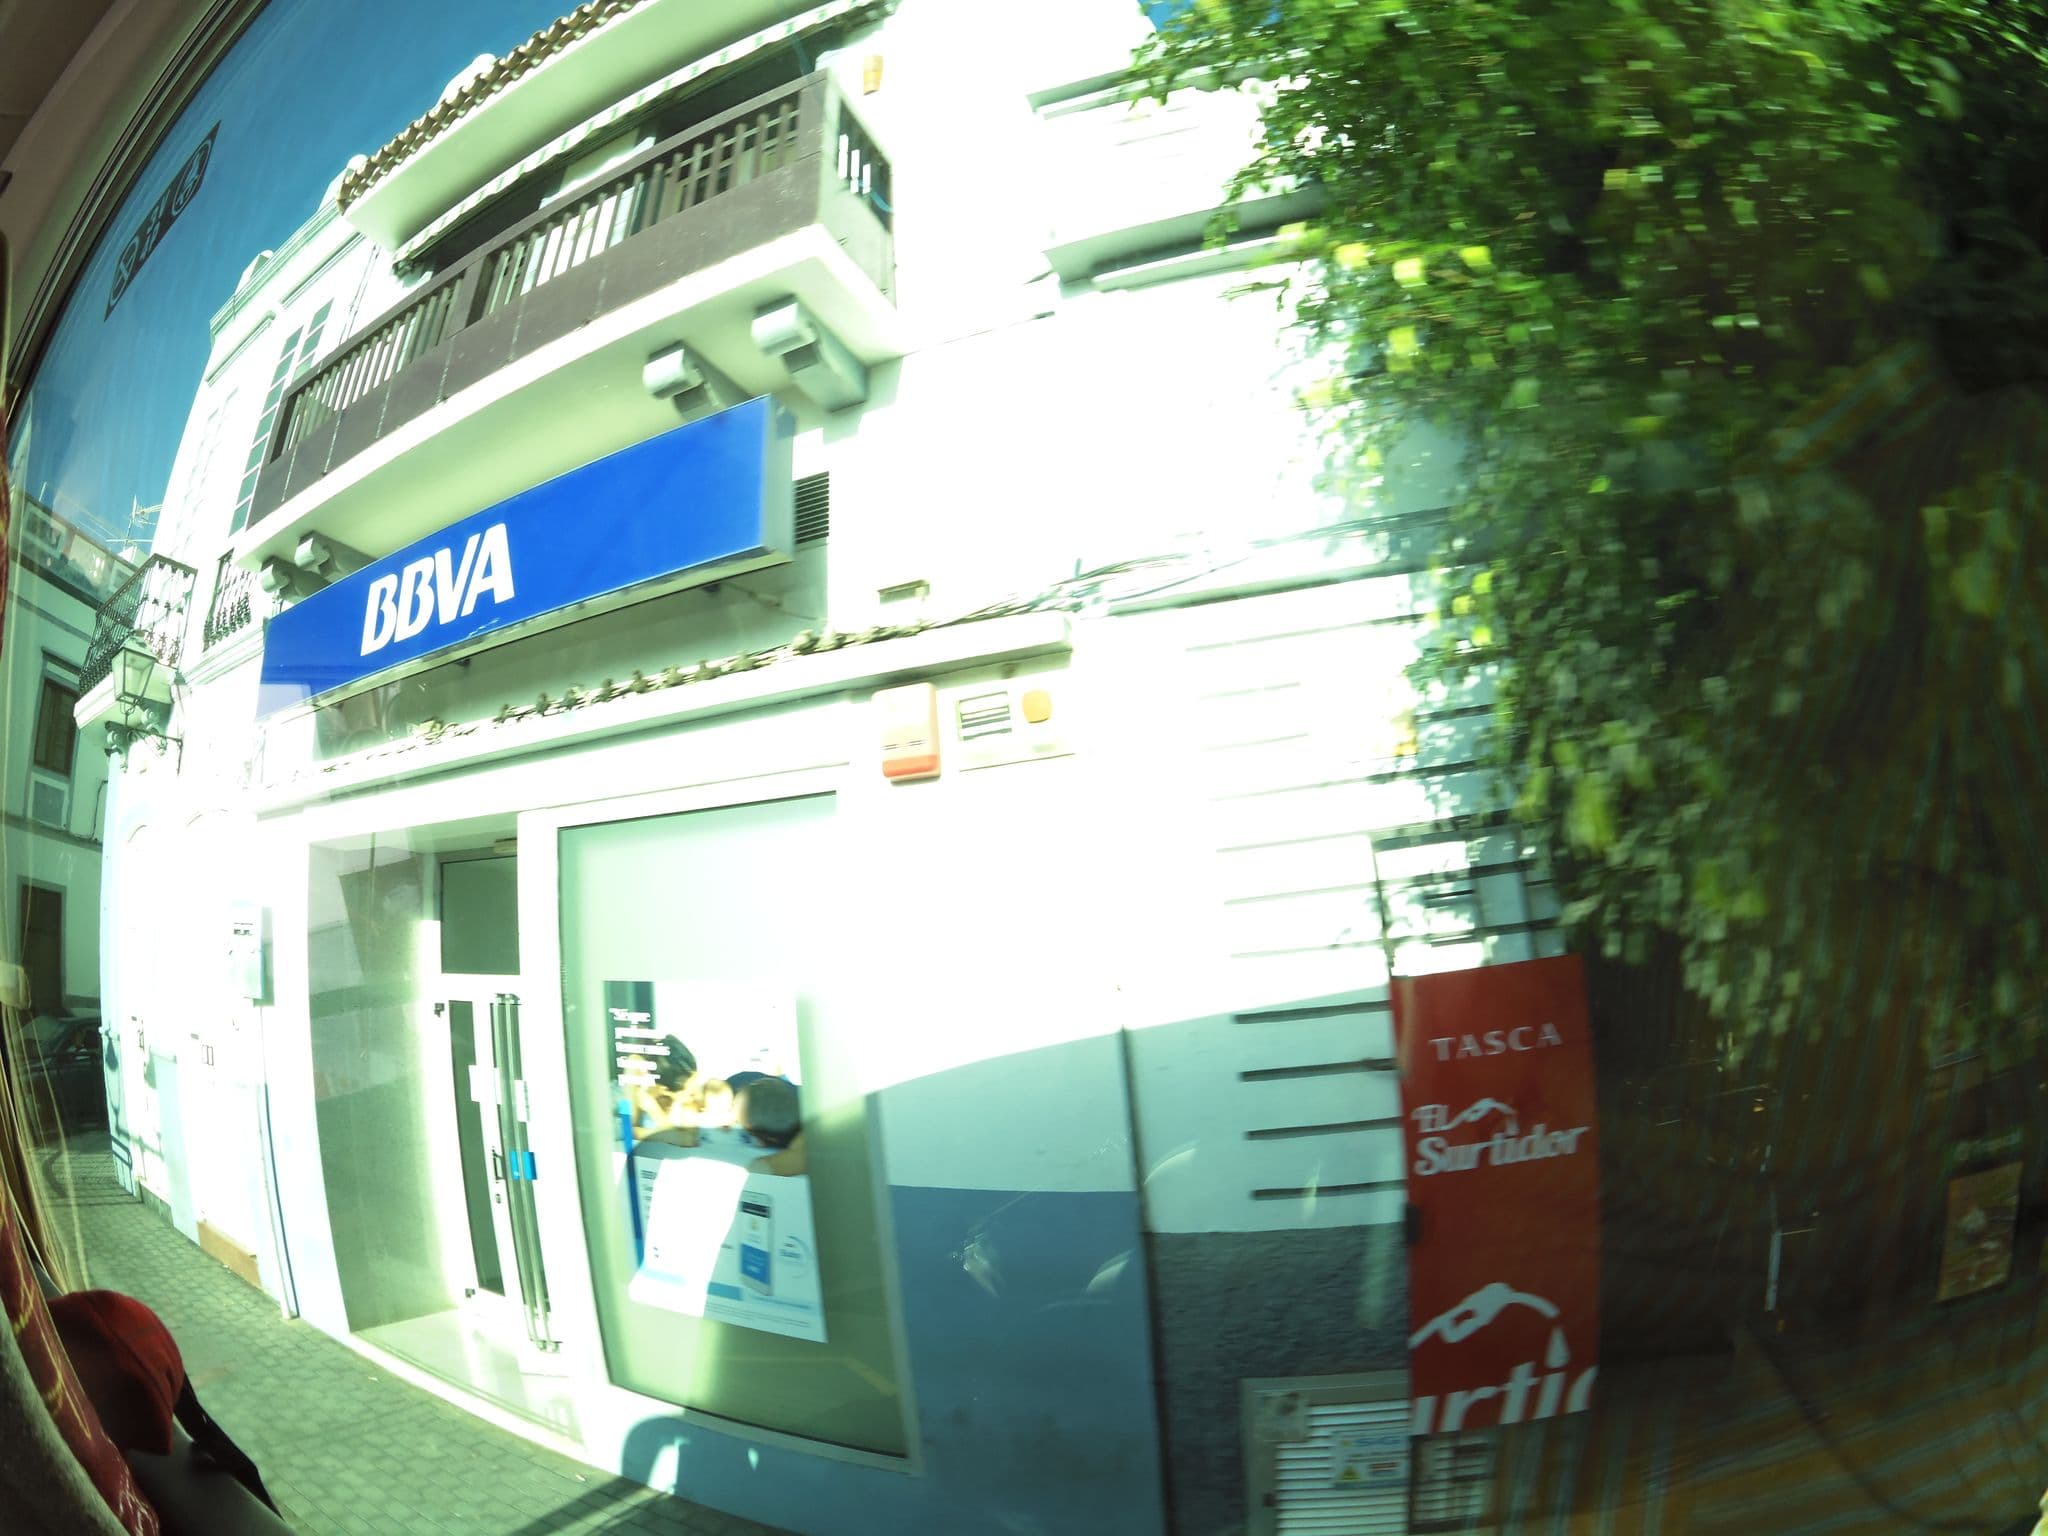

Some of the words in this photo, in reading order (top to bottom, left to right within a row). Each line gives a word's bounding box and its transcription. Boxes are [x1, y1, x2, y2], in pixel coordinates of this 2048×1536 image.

[360, 523, 515, 657] BBVA
[1428, 1023, 1562, 1061] TASCA
[1414, 1124, 1591, 1176] Surtidor
